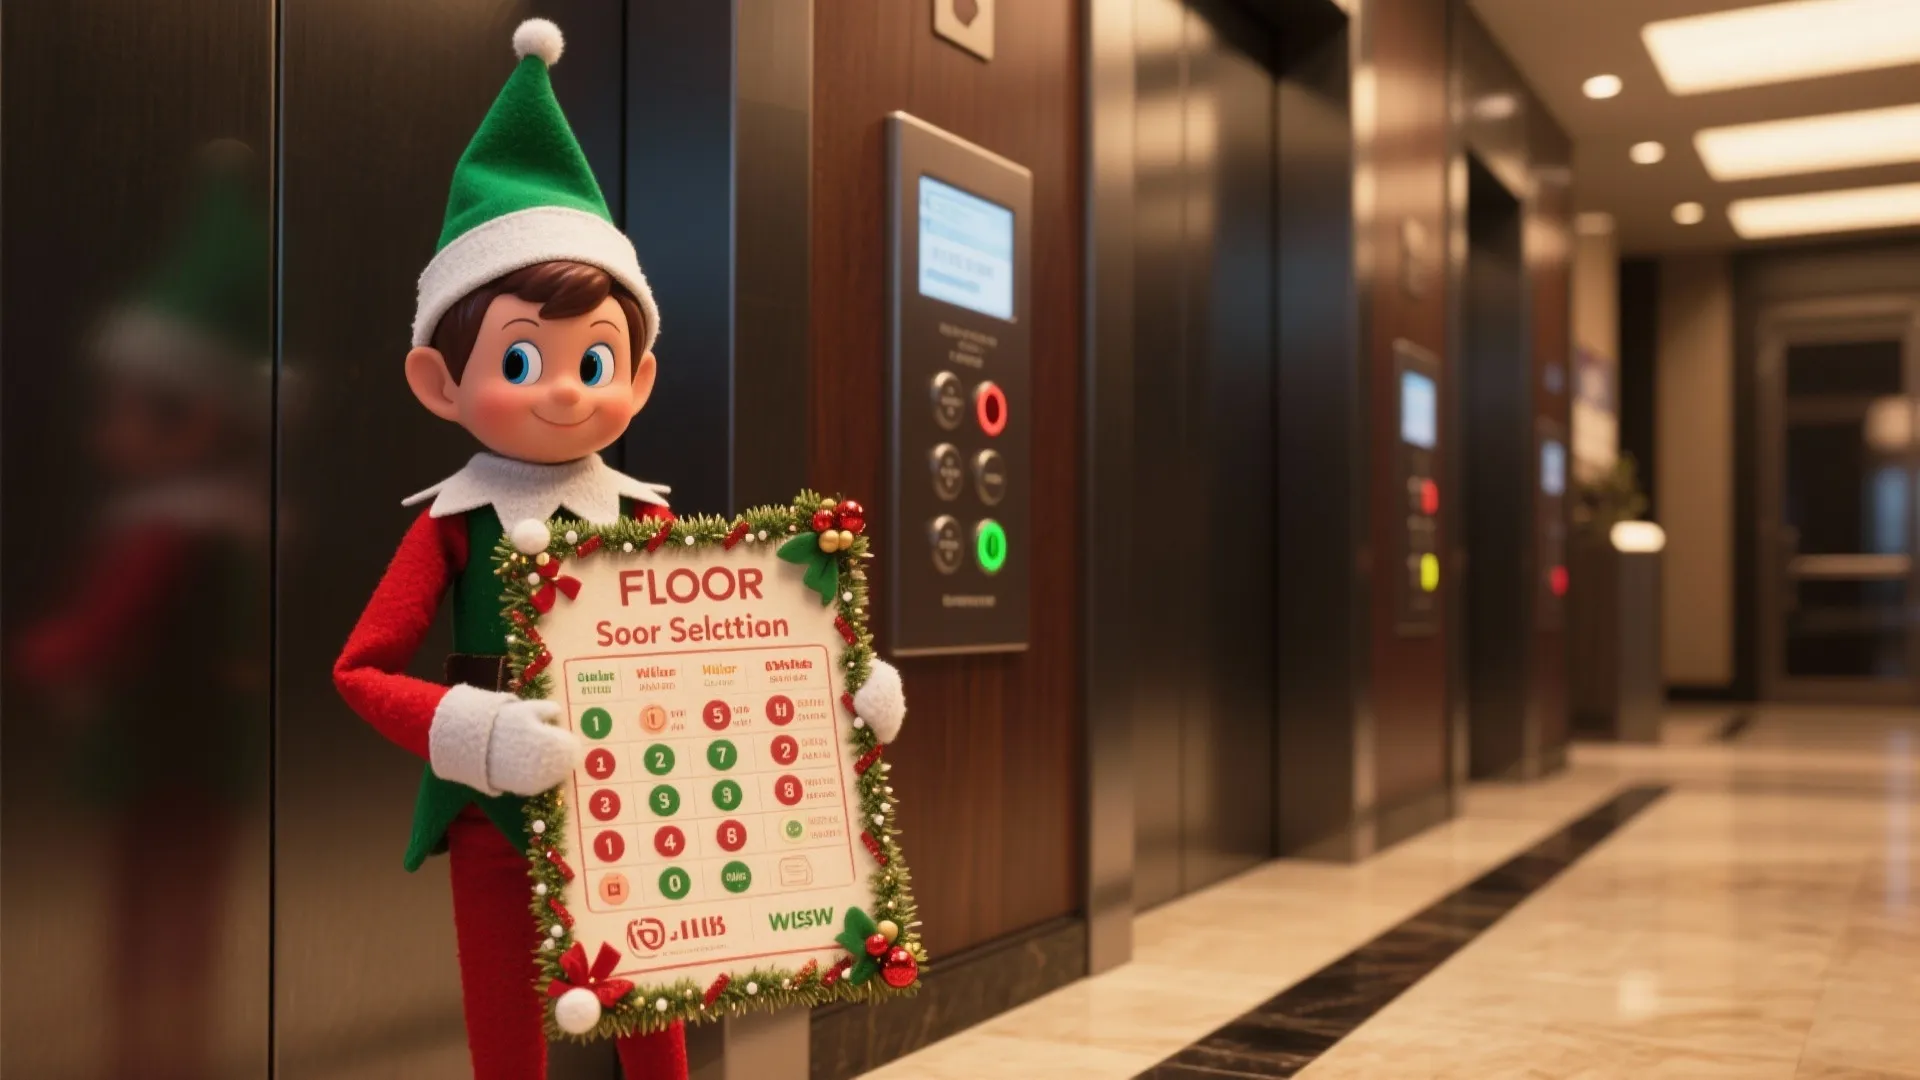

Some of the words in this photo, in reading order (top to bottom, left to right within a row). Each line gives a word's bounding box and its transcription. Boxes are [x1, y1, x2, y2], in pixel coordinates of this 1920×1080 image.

[619, 566, 763, 606] FLOOR
[596, 620, 661, 647] Soor
[592, 715, 600, 732] 1
[712, 707, 724, 723] 5
[655, 751, 667, 769] 2
[716, 747, 727, 764] 7
[780, 743, 791, 759] 2
[596, 756, 607, 773] 1
[605, 837, 613, 855] 1
[664, 833, 677, 851] 4
[669, 874, 681, 892] 0
